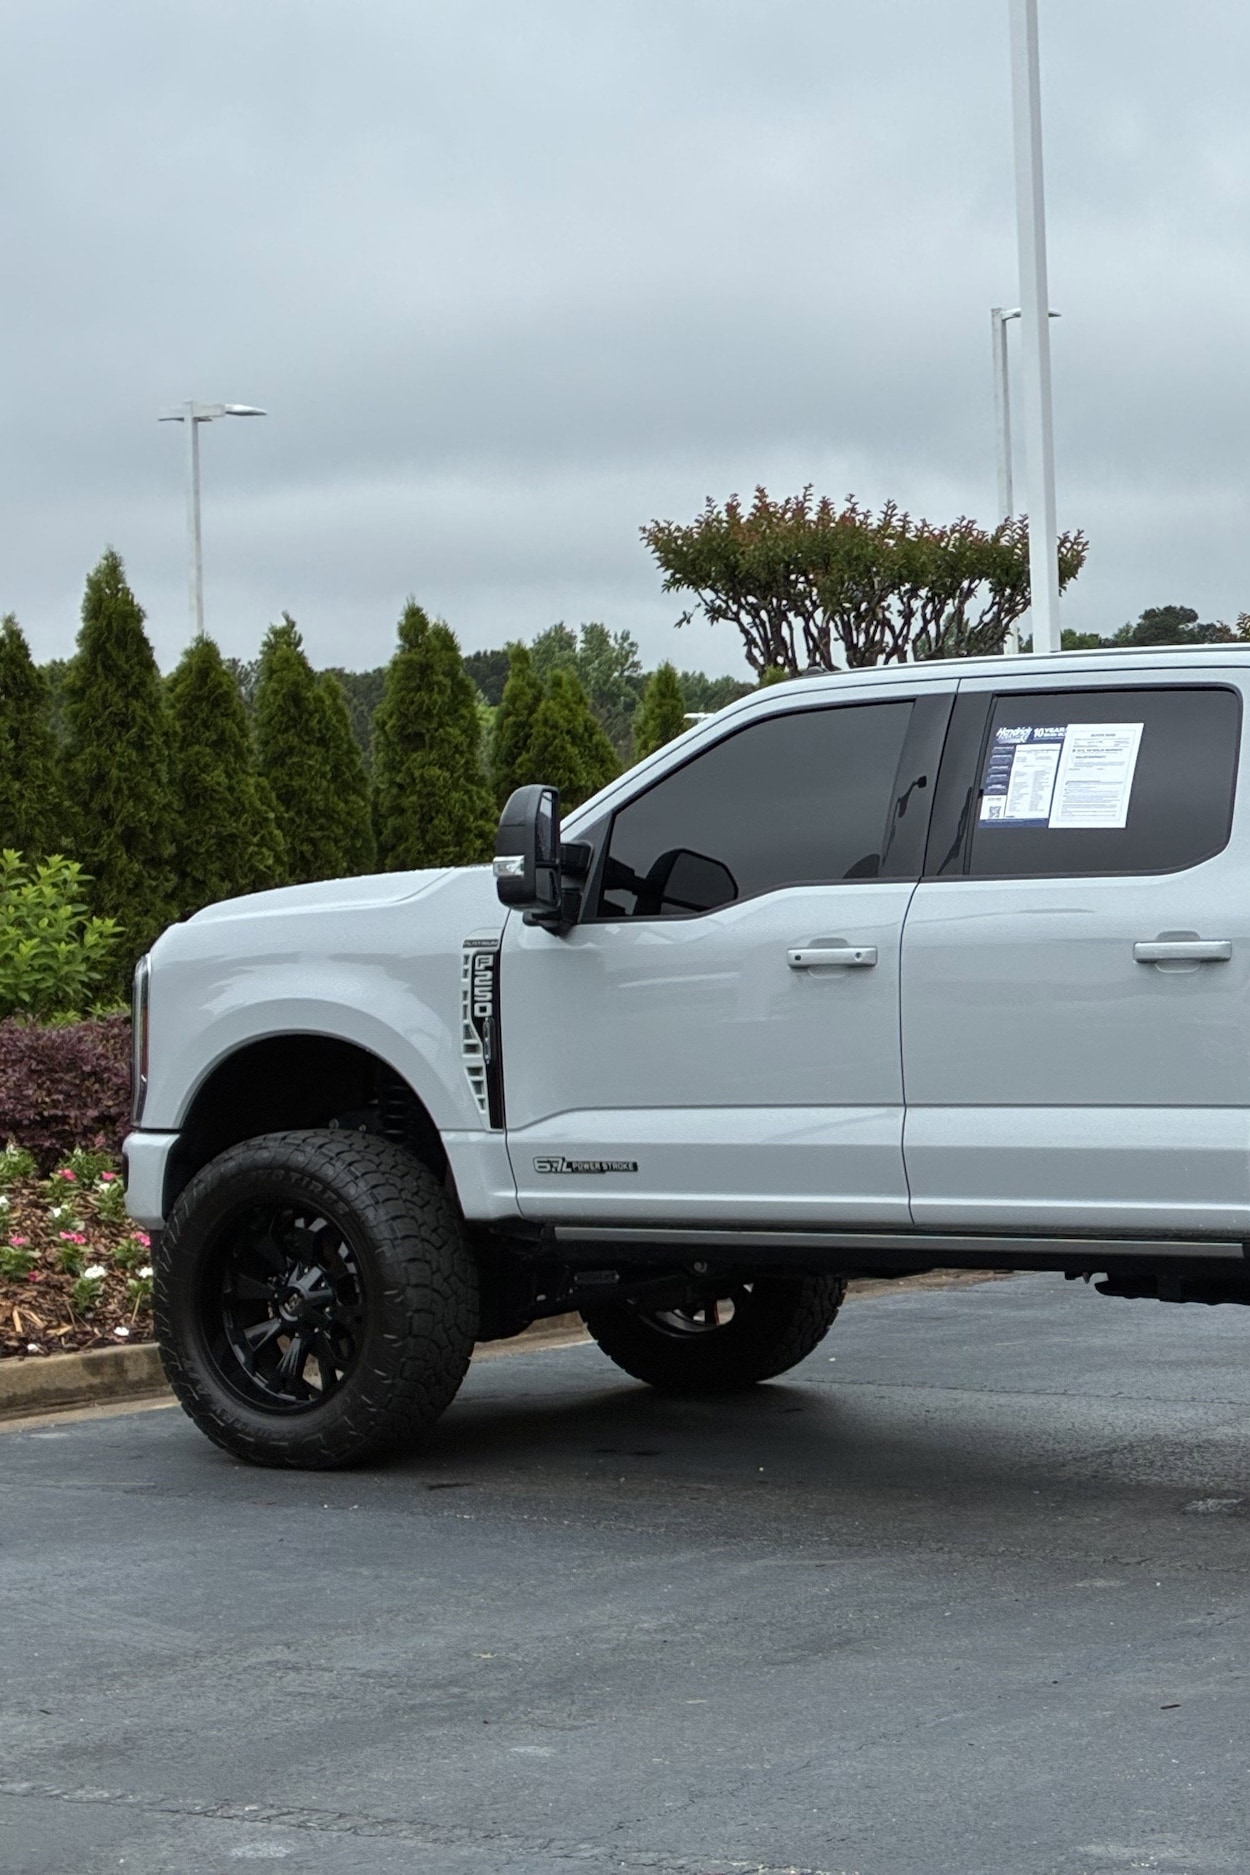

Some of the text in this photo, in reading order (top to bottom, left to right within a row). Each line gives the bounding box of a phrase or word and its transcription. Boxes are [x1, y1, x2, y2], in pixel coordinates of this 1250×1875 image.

[474, 954, 494, 1017] F250
[572, 1162, 601, 1172] POWER
[602, 1161, 634, 1171] STROKE
